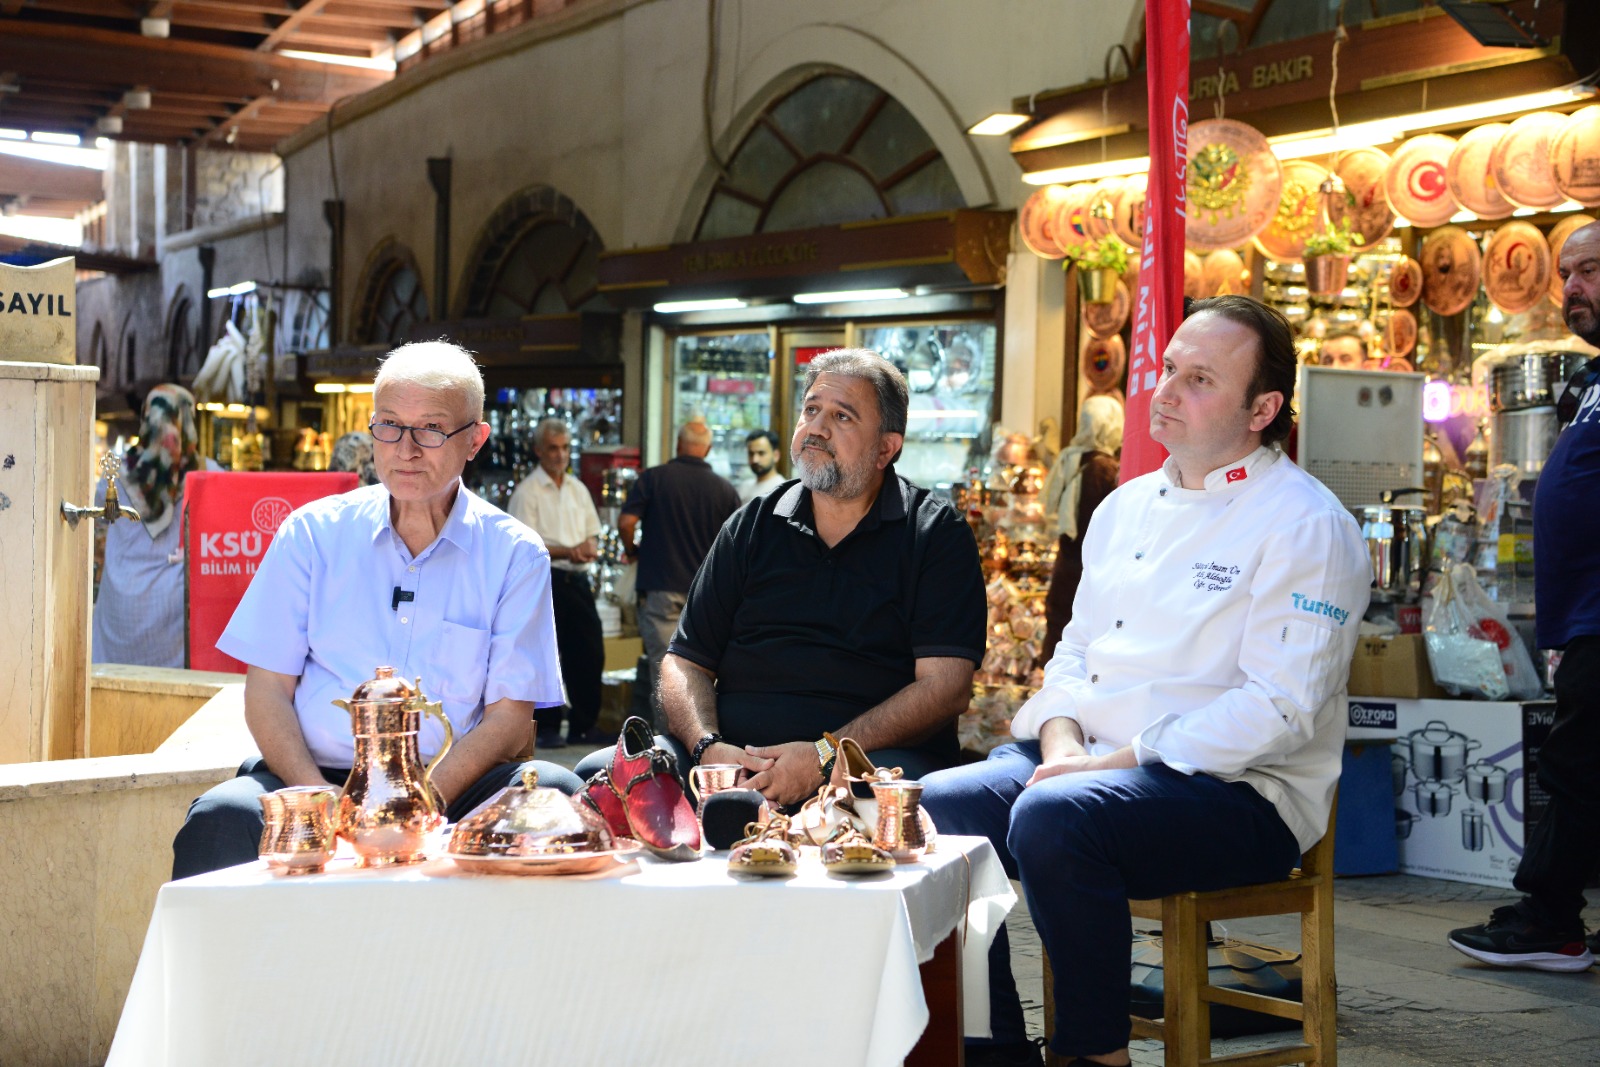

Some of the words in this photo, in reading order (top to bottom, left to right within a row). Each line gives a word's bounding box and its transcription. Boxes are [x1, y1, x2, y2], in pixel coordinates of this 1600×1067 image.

[1188, 70, 1240, 100] URNA
[1250, 55, 1313, 88] BAKIR
[200, 530, 262, 557] KSÜ
[201, 559, 241, 575] BİLİM
[245, 559, 260, 575] İL
[1291, 592, 1350, 626] Turkey
[1353, 707, 1395, 722] OXFORD
